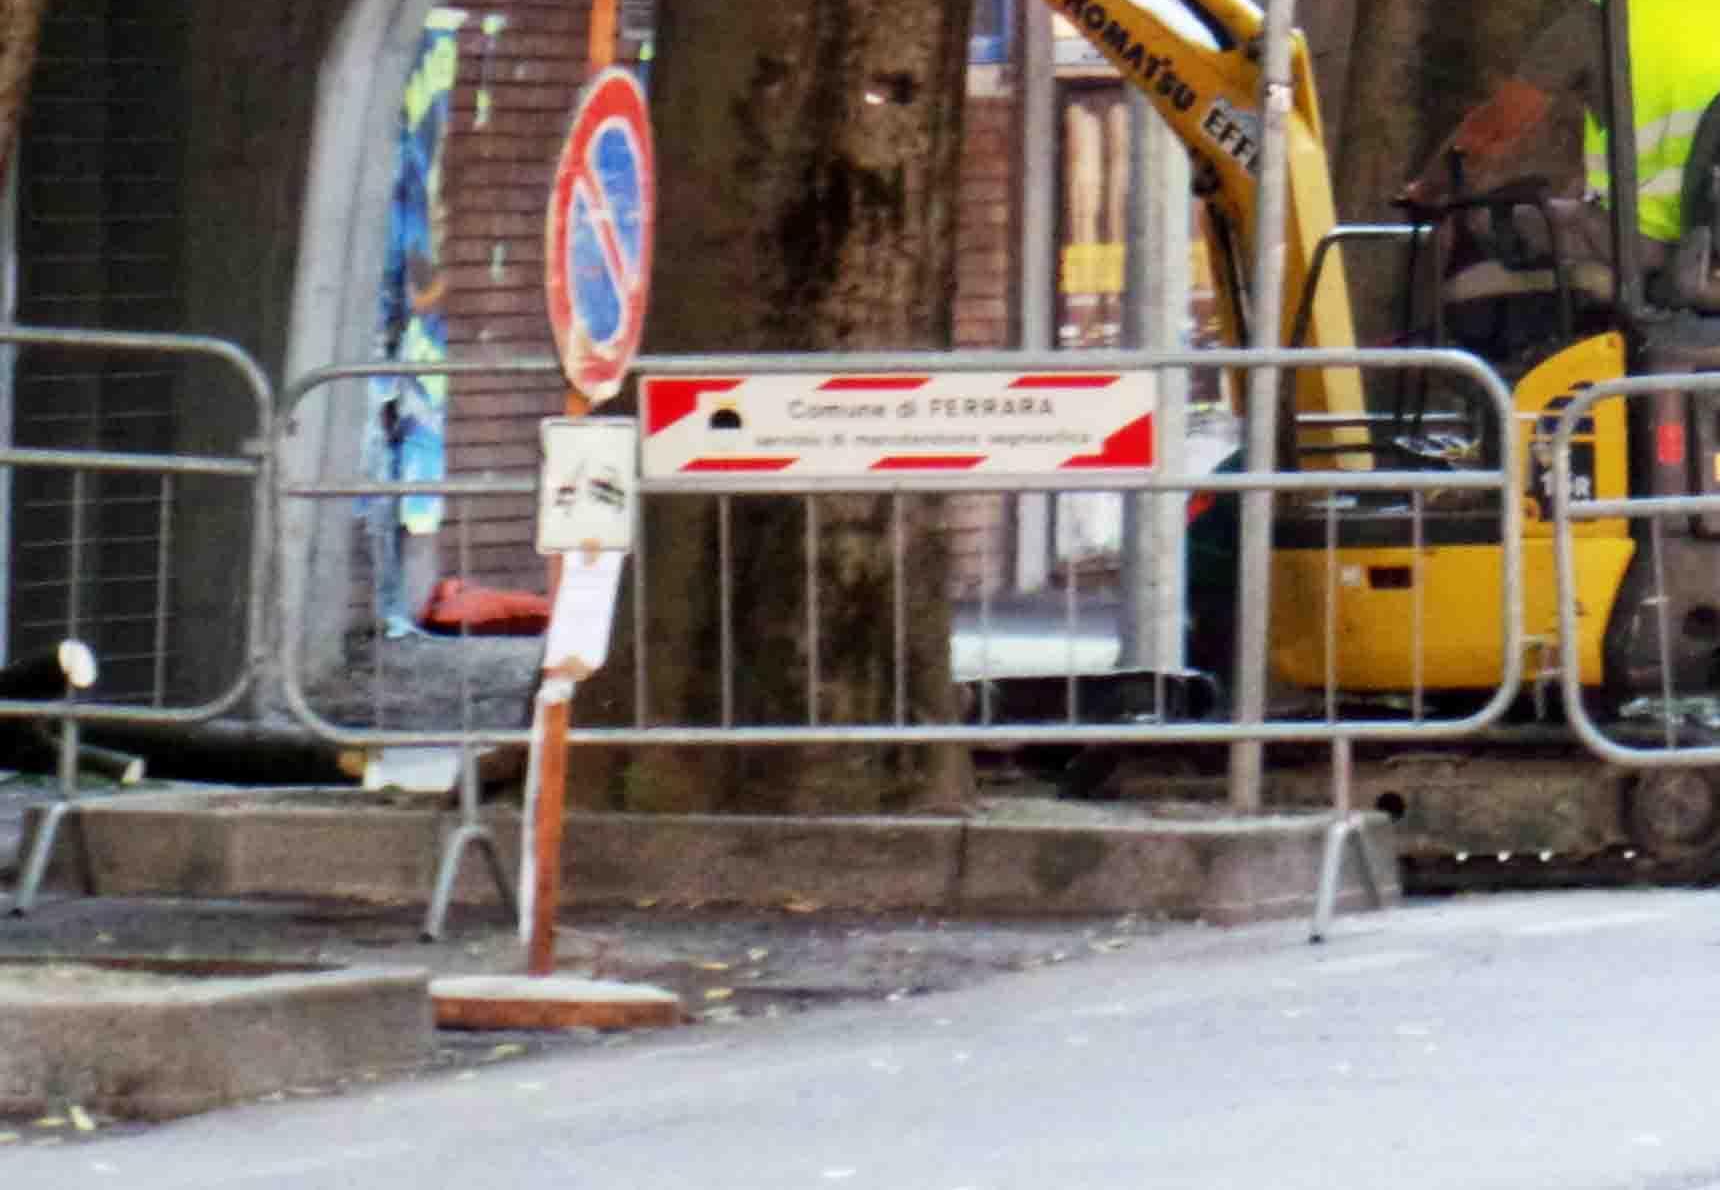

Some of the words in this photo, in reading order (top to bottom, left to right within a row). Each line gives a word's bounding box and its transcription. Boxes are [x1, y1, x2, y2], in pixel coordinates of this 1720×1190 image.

[788, 398, 886, 419] Comune
[898, 398, 917, 418] di
[928, 397, 1054, 418] FERRARA
